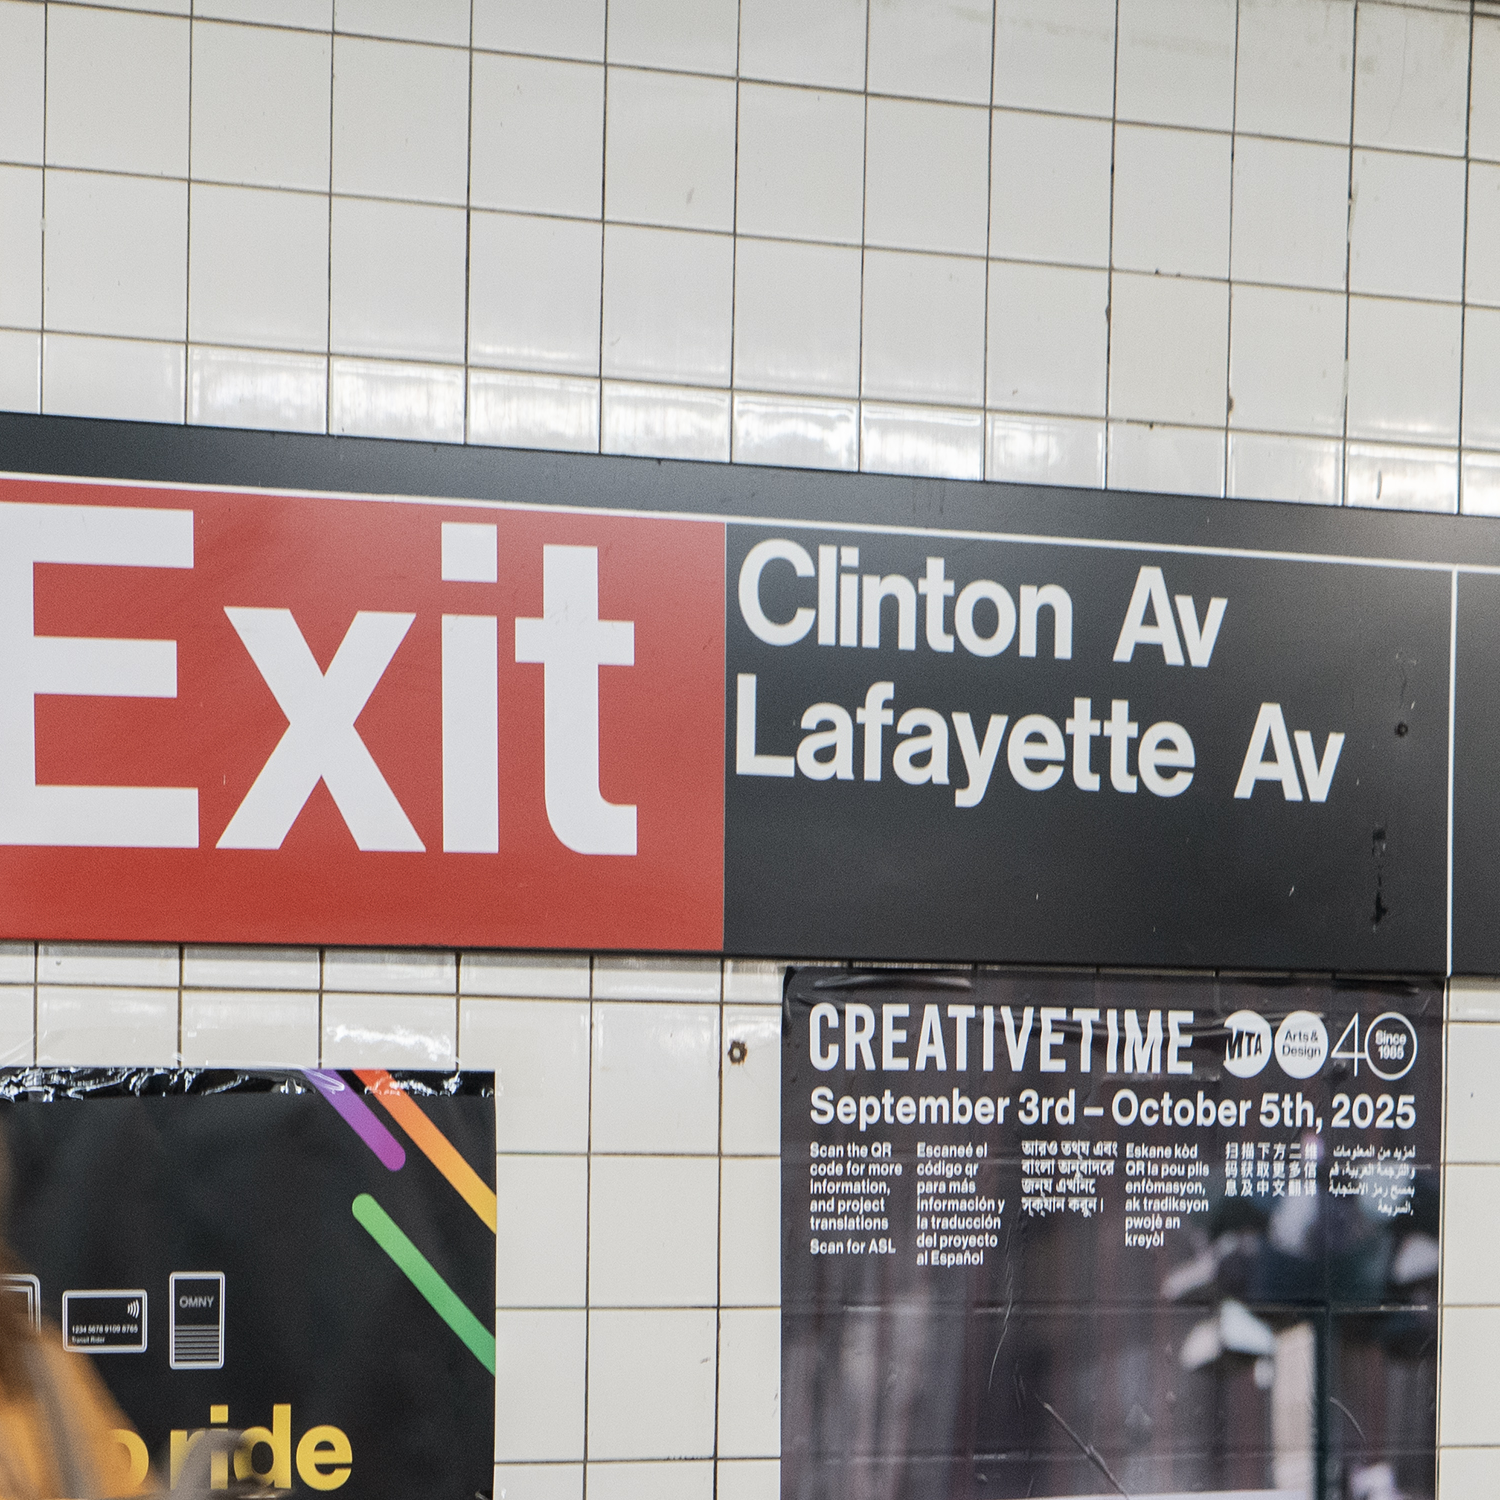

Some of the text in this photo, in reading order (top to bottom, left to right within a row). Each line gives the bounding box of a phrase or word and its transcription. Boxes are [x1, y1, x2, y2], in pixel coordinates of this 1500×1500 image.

[738, 538, 1228, 667] Clinton Av
[736, 672, 1346, 807] Lafayette Av
[1225, 1028, 1263, 1061] MTA
[1375, 1030, 1407, 1045] Since
[1282, 1045, 1321, 1060] Design
[811, 1086, 1010, 1132] September
[1018, 1088, 1075, 1125] 3rd
[1112, 1088, 1251, 1127] October
[1259, 1092, 1323, 1134] 5th,
[1331, 1093, 1416, 1130] 2025
[810, 1141, 892, 1159] Scan the QR
[975, 1142, 988, 1158] el
[1126, 1142, 1198, 1159] Eskane kòd
[810, 1160, 903, 1176] code for more
[917, 1160, 979, 1178] código qr
[1125, 1160, 1210, 1179] QR la pou plis
[810, 1178, 890, 1196] information,
[917, 1178, 976, 1196] para más
[1125, 1178, 1206, 1197] enfòmasyon,
[810, 1197, 885, 1215] and project
[917, 1195, 1005, 1214] información y
[1125, 1196, 1209, 1214] ak tradiksyon
[810, 1215, 889, 1231] translations
[917, 1214, 1001, 1230] la traducción
[1165, 1216, 1181, 1230] an
[810, 1238, 896, 1254] Scan for ASL
[917, 1232, 998, 1250] del proyecto
[917, 1250, 984, 1268] al Español
[179, 1295, 214, 1308] OMNY
[72, 1325, 87, 1334] 1234
[170, 1404, 353, 1491] ride
